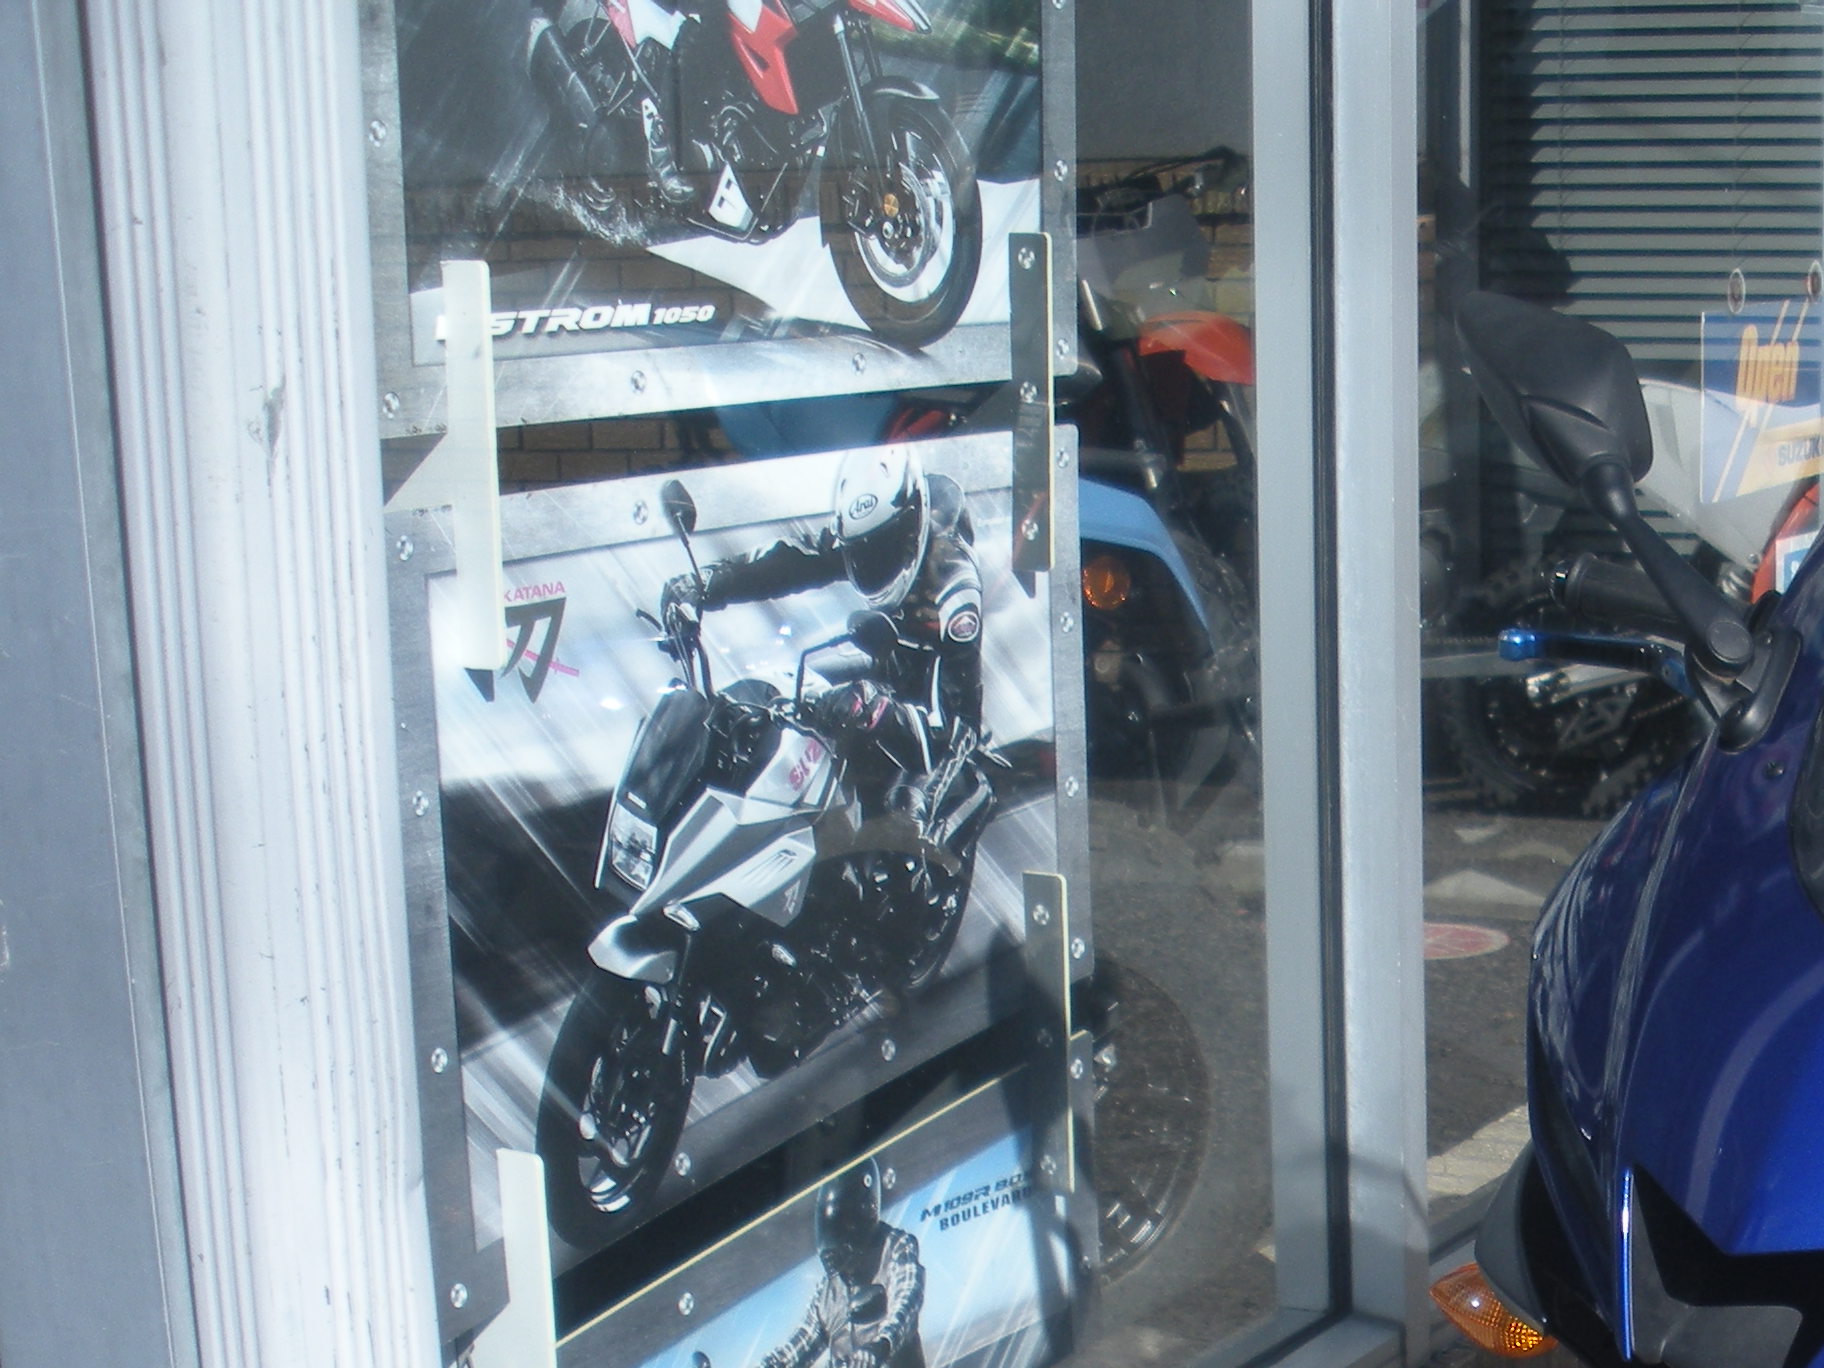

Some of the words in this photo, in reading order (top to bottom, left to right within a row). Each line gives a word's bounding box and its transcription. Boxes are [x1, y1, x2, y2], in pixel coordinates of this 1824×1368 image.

[435, 303, 651, 341] STROM
[652, 304, 715, 325] 1050
[1777, 435, 1824, 466] SUZUKI
[504, 581, 566, 602] KATANA
[920, 1185, 991, 1222] M109R
[939, 1186, 1032, 1231] BOULEVARD
